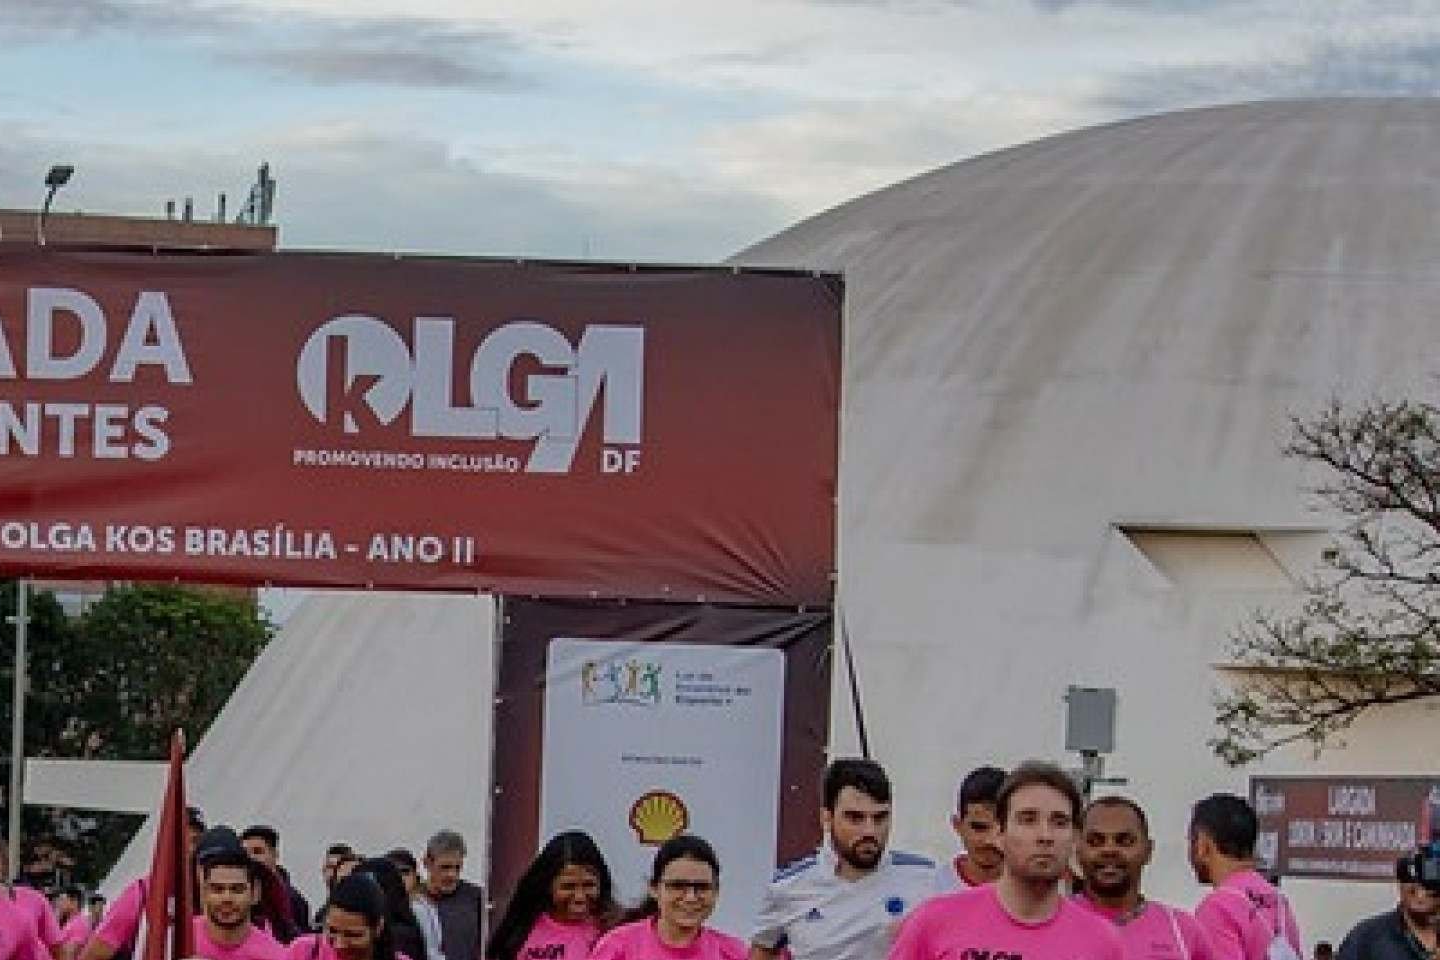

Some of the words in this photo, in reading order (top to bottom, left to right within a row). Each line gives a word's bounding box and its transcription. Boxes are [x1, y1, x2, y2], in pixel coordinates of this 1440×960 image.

[293, 449, 424, 470] PROMOVENDO
[428, 453, 519, 473] INCLUSÃO
[602, 449, 641, 473] DF
[1, 522, 96, 552] OLGA
[105, 525, 176, 553] KOS
[185, 523, 337, 560] BRASÍLIA
[367, 535, 443, 564] ANO
